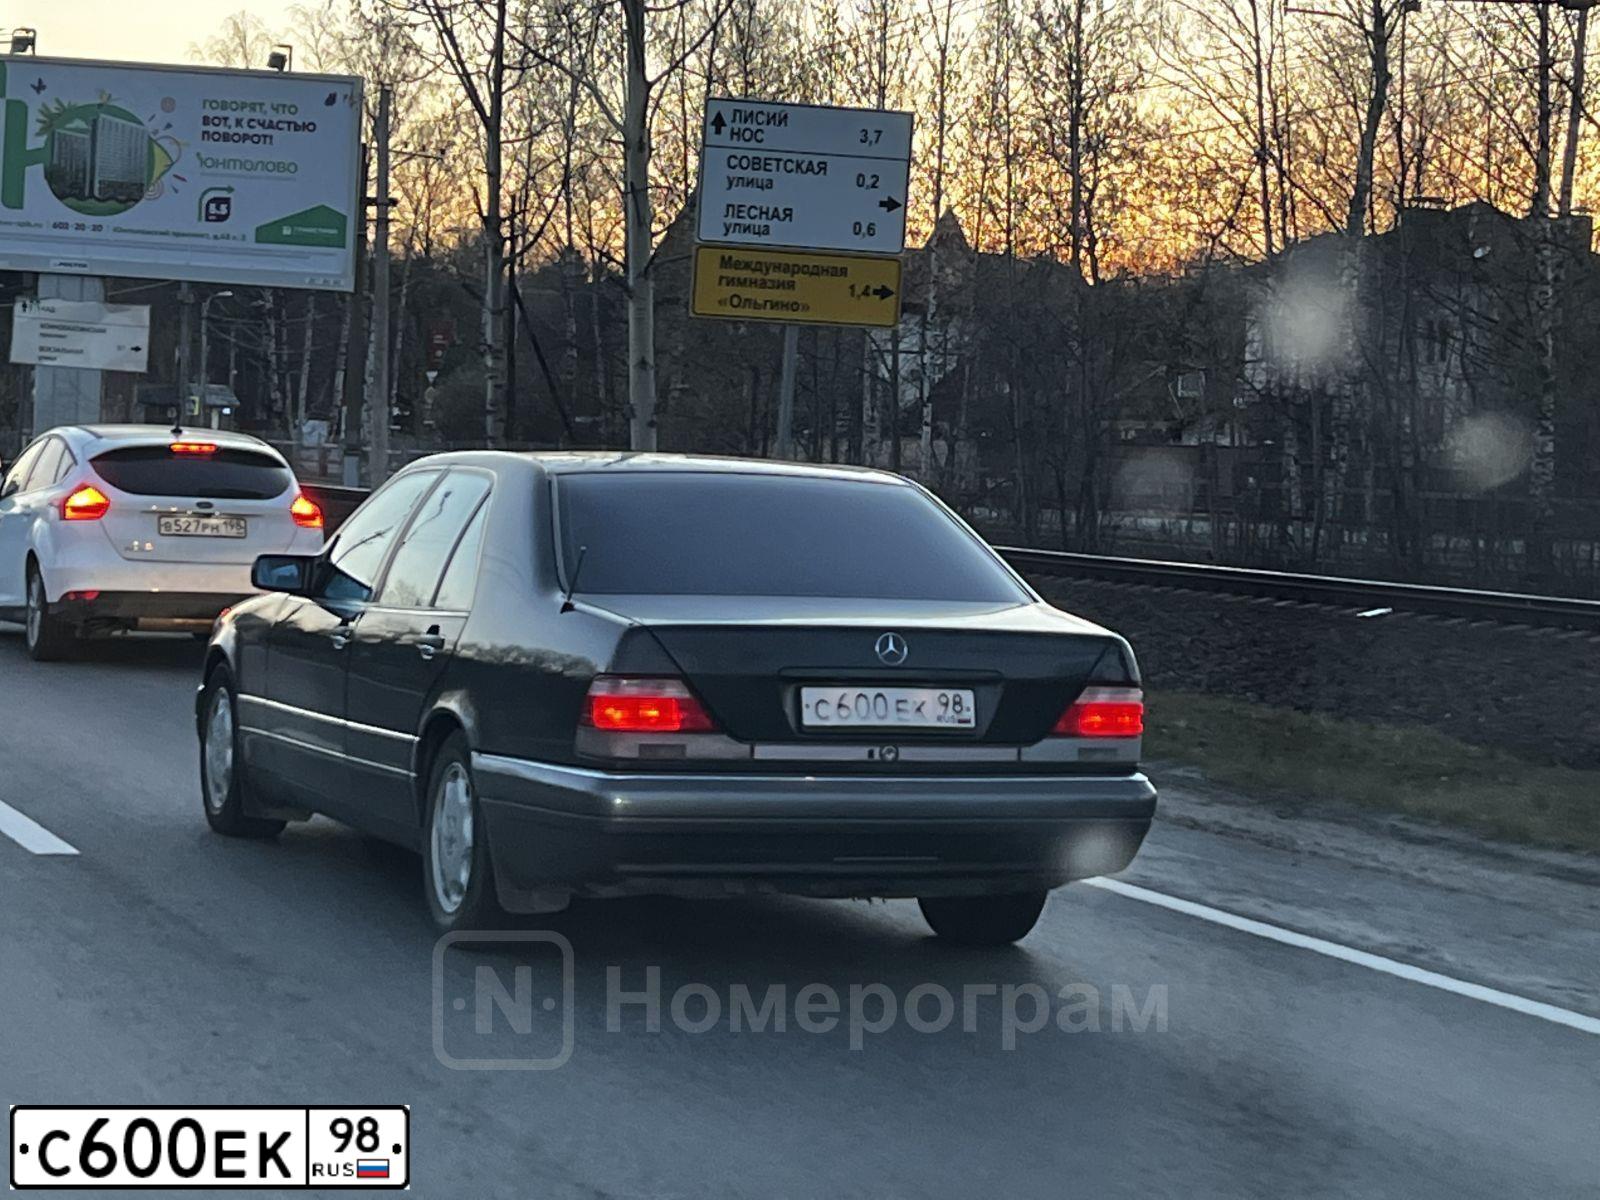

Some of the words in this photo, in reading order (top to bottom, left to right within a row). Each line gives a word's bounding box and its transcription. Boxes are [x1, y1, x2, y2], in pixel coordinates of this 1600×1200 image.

[202, 99, 267, 115] ГОВОРЯТ,
[270, 103, 298, 115] ЧТО
[202, 115, 231, 129] ВОТ,
[235, 118, 243, 129] К
[247, 118, 317, 132] СЧАСТЬЮ
[730, 109, 788, 127] ЛИСИЙ
[201, 130, 273, 145] ПОВОРОТ!
[729, 128, 764, 143] НОС
[859, 129, 883, 146] 3,7
[727, 155, 827, 176] СОВЕТСКАЯ
[726, 176, 773, 191] улица
[856, 173, 880, 190] 0,2
[724, 204, 793, 221] ЛЕСНАЯ
[723, 221, 770, 237] улица
[853, 222, 876, 238] 0,6
[719, 255, 848, 278] Международная
[718, 274, 795, 291] гимназия
[849, 284, 871, 298] 1,4
[718, 294, 810, 313] «Ольгино»
[937, 693, 963, 714] 98
